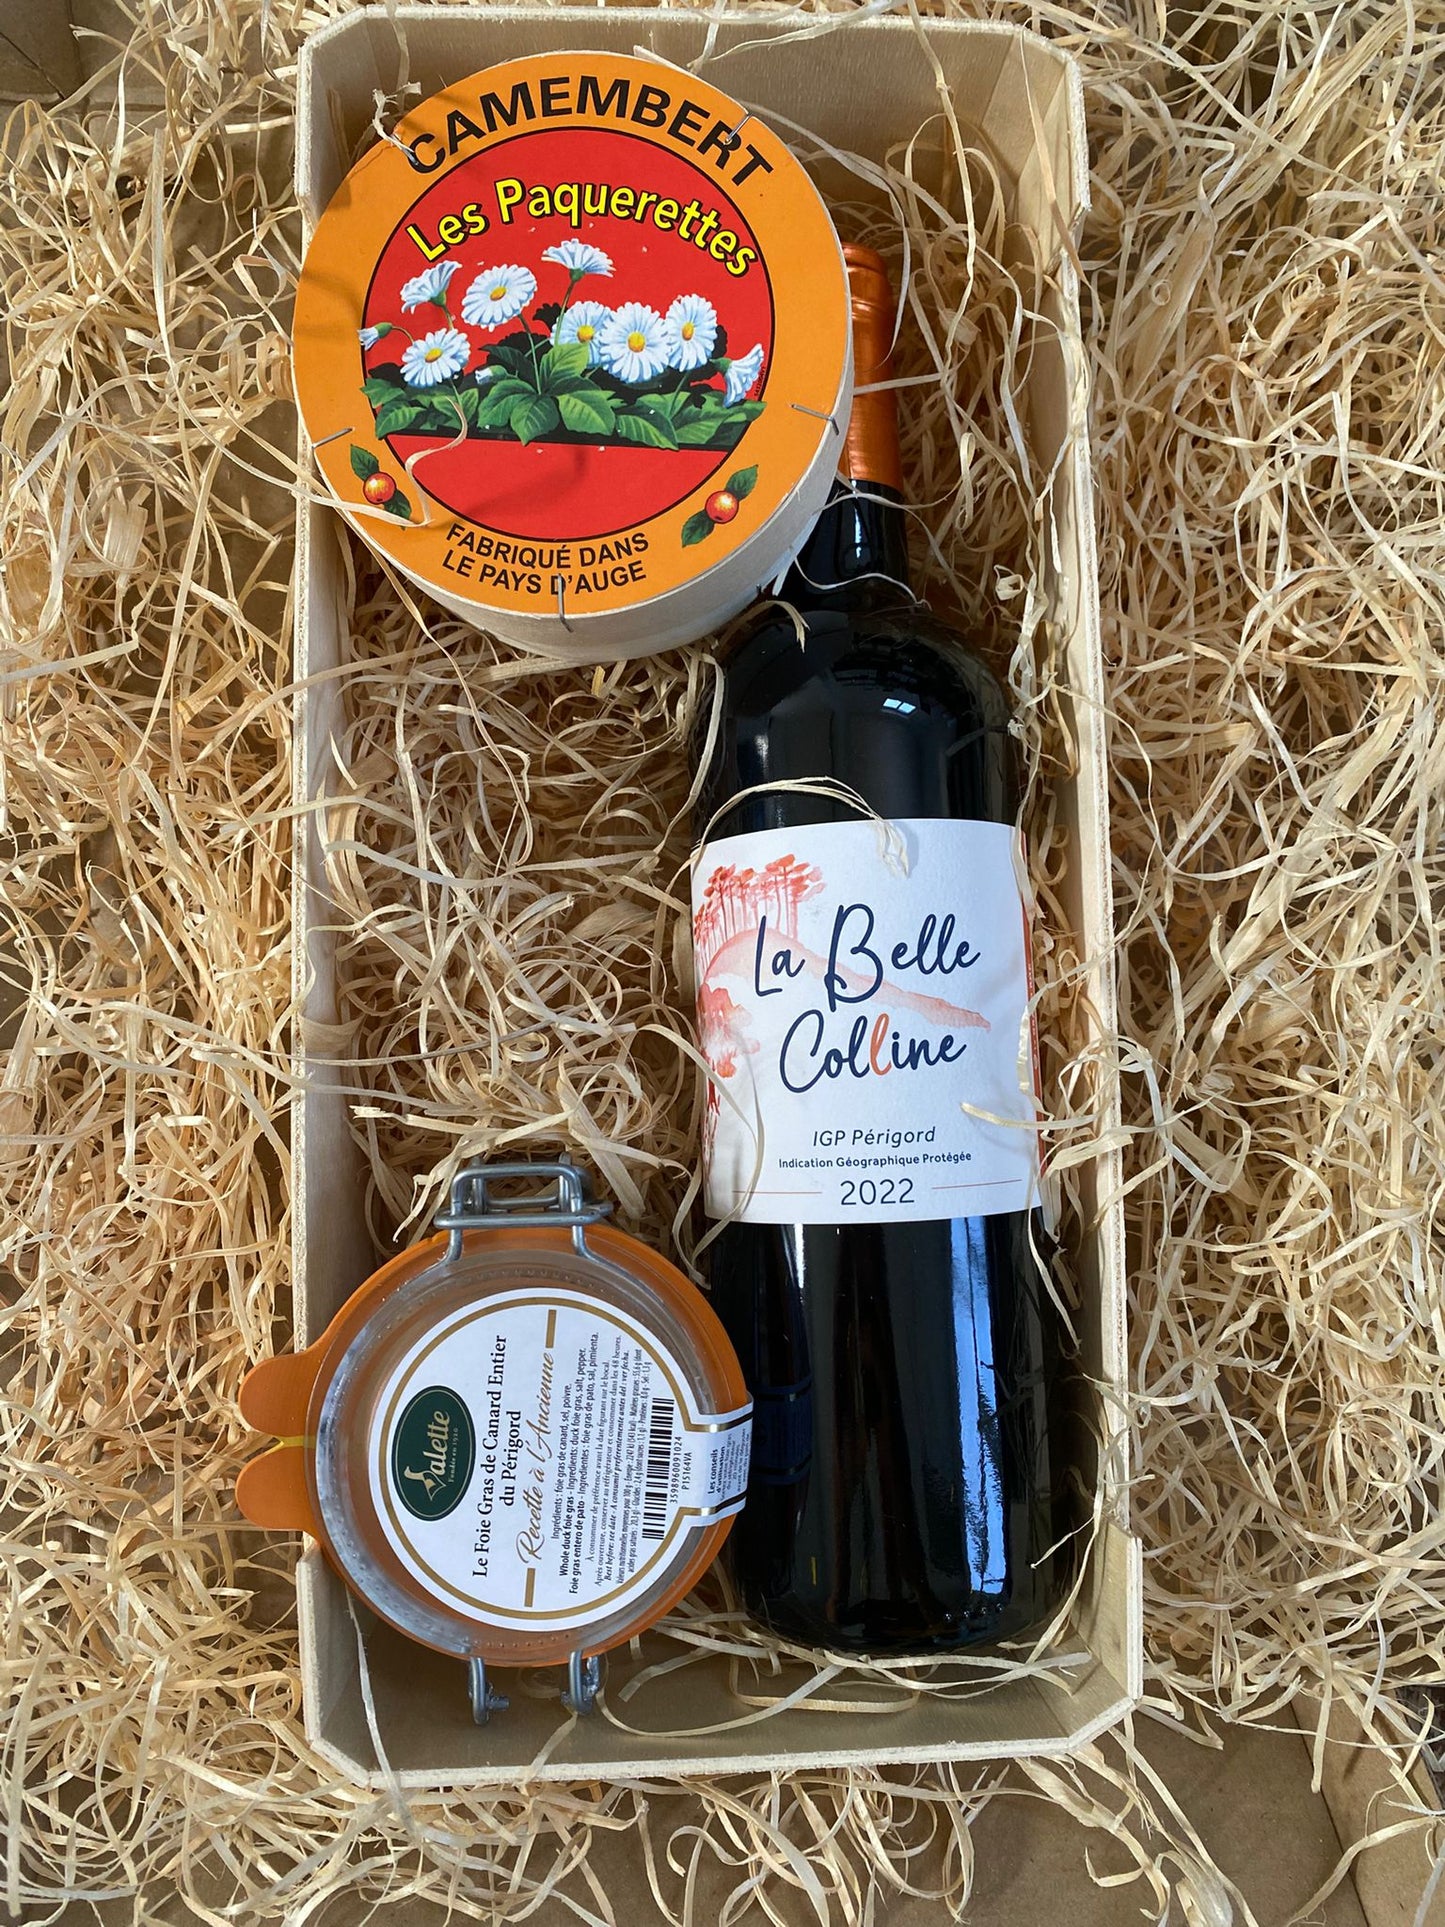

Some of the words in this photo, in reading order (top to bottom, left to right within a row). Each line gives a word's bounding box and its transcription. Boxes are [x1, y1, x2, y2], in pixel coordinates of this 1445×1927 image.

[407, 75, 774, 186] CAMEMBERT
[406, 201, 490, 263] Les
[494, 177, 759, 277] Paquerettes
[446, 526, 571, 570] FABRIQUÉ
[579, 532, 650, 570] DANS
[442, 548, 474, 579] LE
[479, 563, 541, 597] PAYS
[550, 561, 648, 596] D'AUGE
[754, 915, 806, 998] La
[823, 903, 982, 1012] Belle
[779, 1009, 968, 1094] Colline
[812, 1130, 846, 1148] IGP
[851, 1126, 937, 1149] Périgord
[778, 1156, 834, 1169] Indication
[835, 1153, 920, 1170] Géographique
[922, 1150, 972, 1167] Protégée
[840, 1178, 916, 1206] 2022
[487, 1334, 506, 1386] Entier
[587, 1331, 600, 1367] pimienta.
[577, 1347, 587, 1375] pepper.
[573, 1376, 584, 1392] salt,
[586, 1368, 596, 1381] sal,
[560, 1382, 573, 1408] poivre.
[573, 1393, 584, 1411] gras,
[585, 1382, 596, 1400] pato,
[522, 1351, 559, 1462] l'Ancienne
[559, 1409, 570, 1421] sel,
[583, 1401, 592, 1411] de
[481, 1390, 501, 1450] Canard
[570, 1412, 580, 1426] foie
[583, 1412, 594, 1428] gras
[500, 1409, 525, 1481] Périgord
[557, 1423, 569, 1450] canard,
[569, 1427, 579, 1445] duck
[580, 1429, 590, 1443] foie
[480, 1454, 496, 1473] de
[556, 1451, 566, 1460] de
[709, 1448, 718, 1479] conseils
[527, 1467, 544, 1482] à
[557, 1461, 567, 1477] gras
[566, 1446, 579, 1489] Ingredients:
[577, 1448, 591, 1494] Ingredientes
[669, 1435, 682, 1503] 3598960091024
[681, 1451, 692, 1490] P15164VA
[476, 1477, 494, 1515] Gras
[498, 1485, 514, 1506] du
[554, 1478, 564, 1492] foie
[707, 1482, 715, 1494] Les
[565, 1496, 576, 1513] gras
[576, 1500, 586, 1518] pato
[514, 1484, 548, 1564] Recette
[550, 1497, 564, 1539] Ingrédients
[562, 1514, 572, 1529] foie
[574, 1519, 583, 1530] de
[473, 1519, 491, 1553] Foie
[560, 1530, 571, 1549] duck
[572, 1531, 582, 1557] entero
[472, 1557, 488, 1577] Le
[558, 1550, 569, 1576] Whole
[572, 1558, 582, 1576] gras
[568, 1577, 578, 1593] Foie
